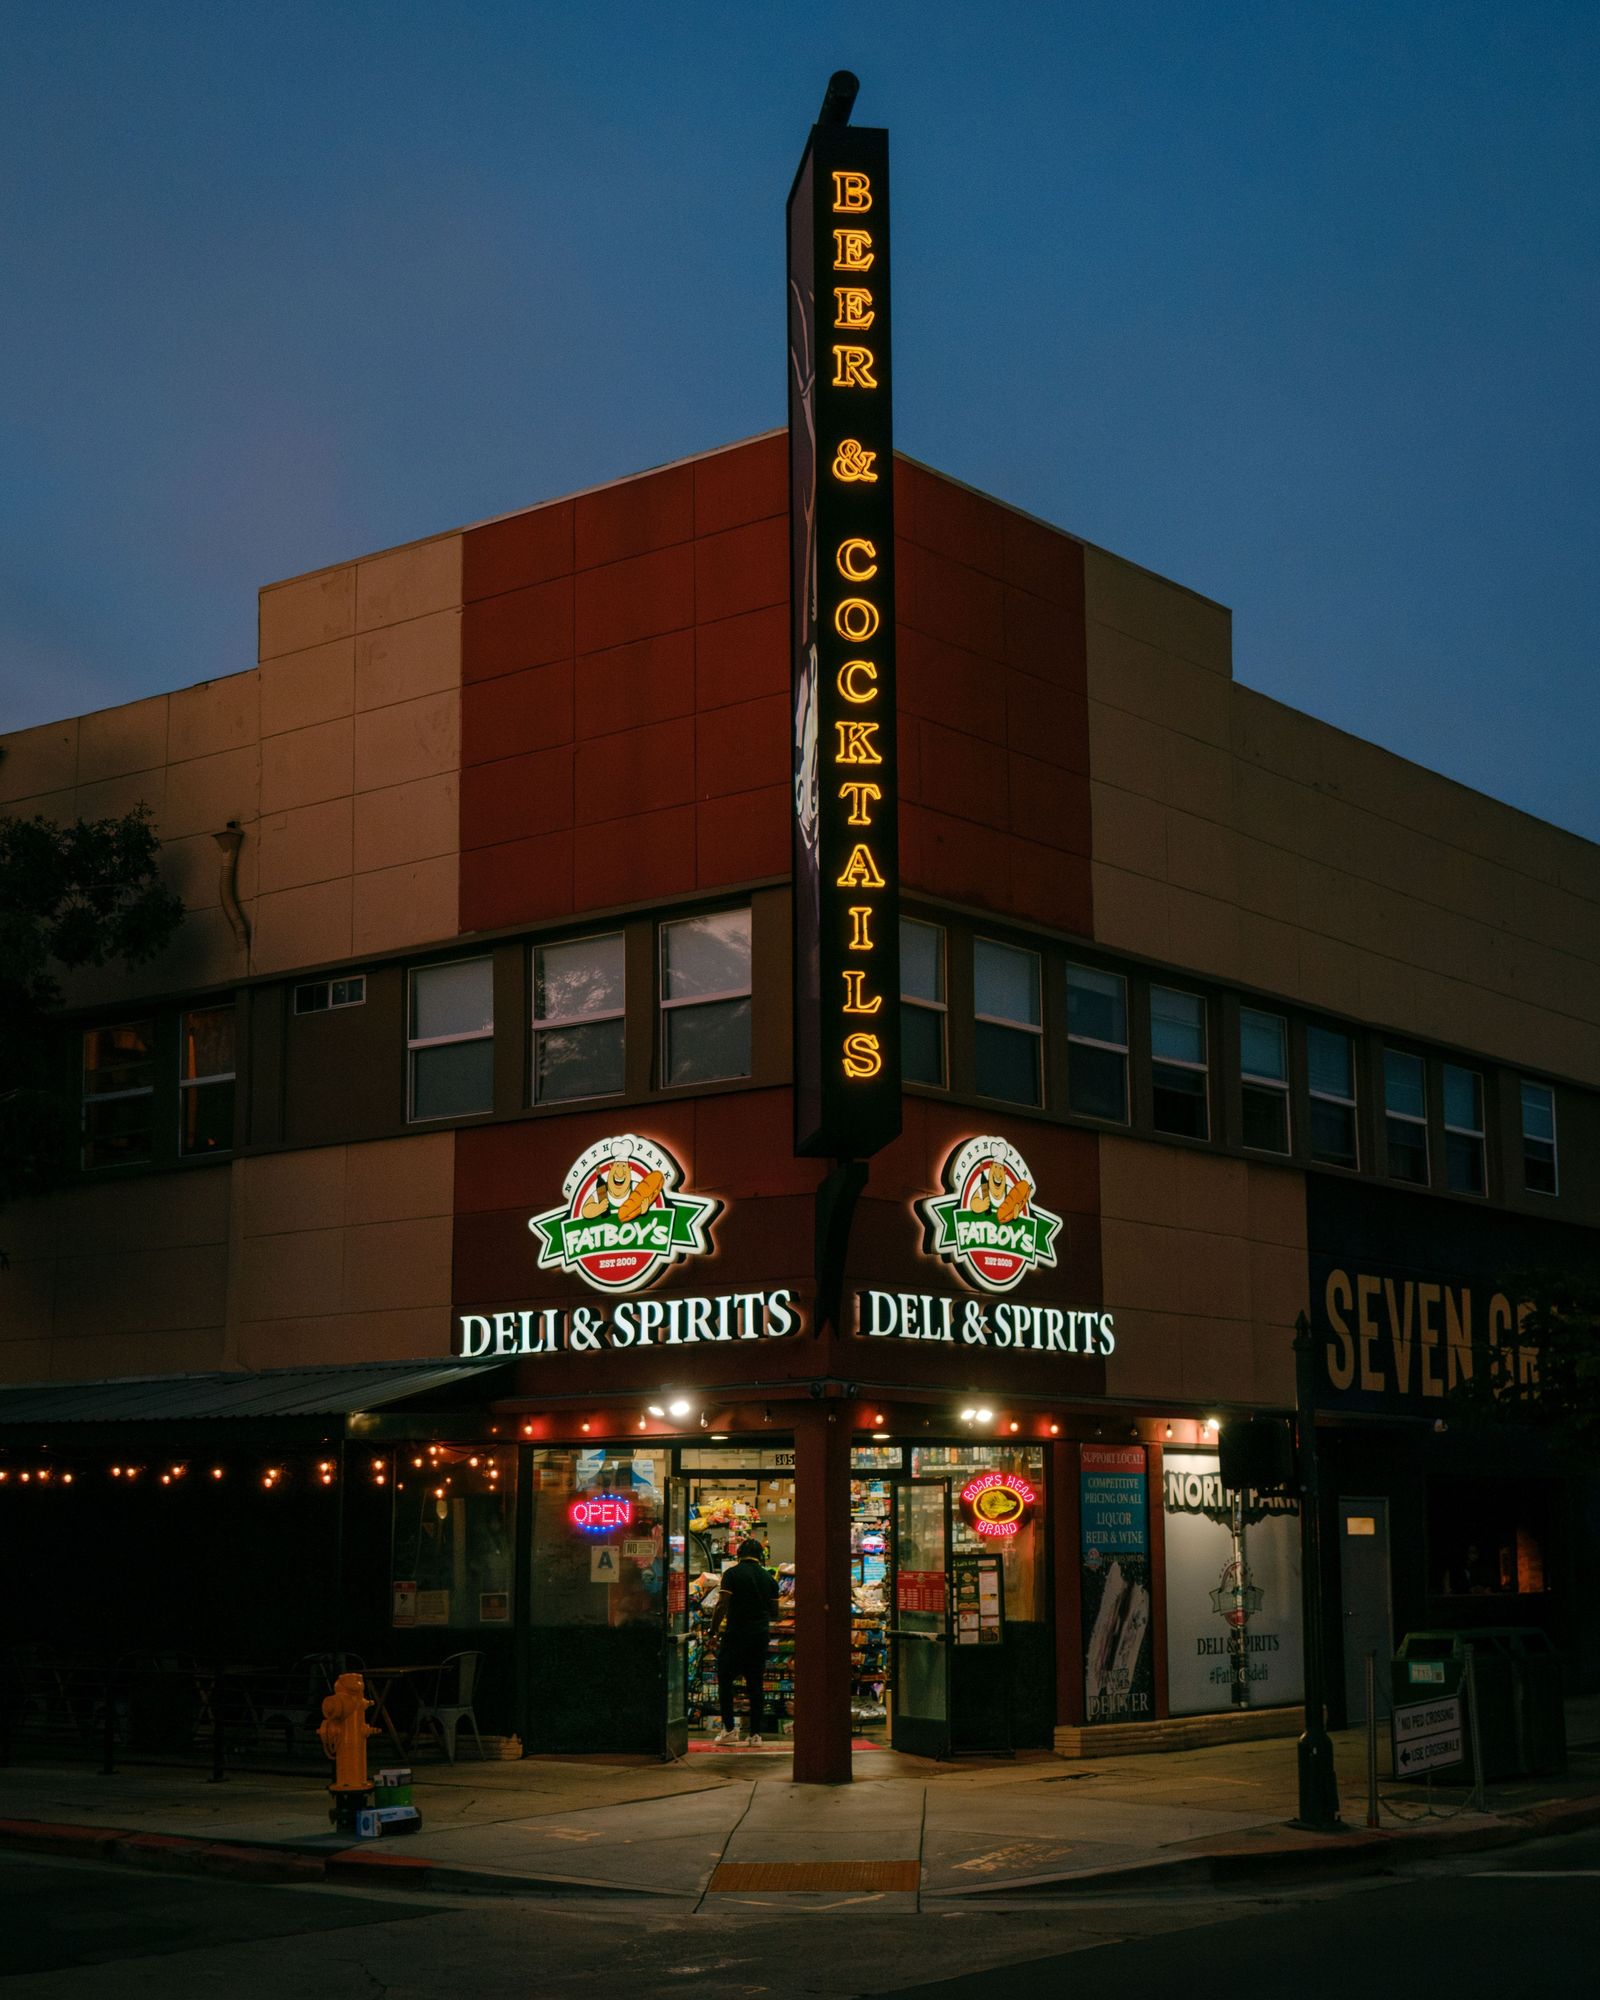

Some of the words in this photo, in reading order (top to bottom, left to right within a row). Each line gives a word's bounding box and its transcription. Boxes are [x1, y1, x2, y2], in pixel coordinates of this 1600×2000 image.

[832, 171, 877, 389] BEER
[832, 438, 877, 483] &
[835, 537, 886, 1079] COCKTAILS
[564, 1143, 610, 1193] NORTH
[636, 1143, 672, 1181] PARK
[955, 1141, 989, 1183] NORTH
[1008, 1149, 1034, 1191] PARK
[564, 1216, 670, 1257] FATBOY'S
[957, 1221, 1034, 1253] FATBOY'S
[599, 1258, 616, 1268] EST
[617, 1256, 637, 1267] 2009
[459, 1308, 559, 1358] DELI
[570, 1306, 604, 1351] &
[611, 1289, 793, 1348] SPIRITS
[868, 1290, 954, 1341] DELI
[962, 1300, 989, 1345] &
[994, 1302, 1116, 1356] SPIRITS
[1325, 1267, 1474, 1399] SEVEN
[776, 1454, 796, 1466] 305
[1082, 1451, 1116, 1464] SUPPORT
[963, 1474, 1002, 1501] BOAR'S
[1006, 1475, 1035, 1502] HEAD
[1087, 1477, 1140, 1489] COMPETITIVE
[1085, 1492, 1116, 1504] PRICING
[573, 1503, 630, 1523] OPEN
[1096, 1511, 1132, 1527] LIQUOR
[977, 1520, 1017, 1536] BRAND
[1086, 1530, 1108, 1544] BEER
[1119, 1530, 1145, 1544] WINE
[597, 1551, 613, 1569] A
[1197, 1637, 1224, 1656] DELI
[1242, 1633, 1280, 1653] PIRITS
[1089, 1692, 1150, 1716] DELIVER
[1412, 1713, 1425, 1728] PED
[1411, 1746, 1425, 1761] USE
